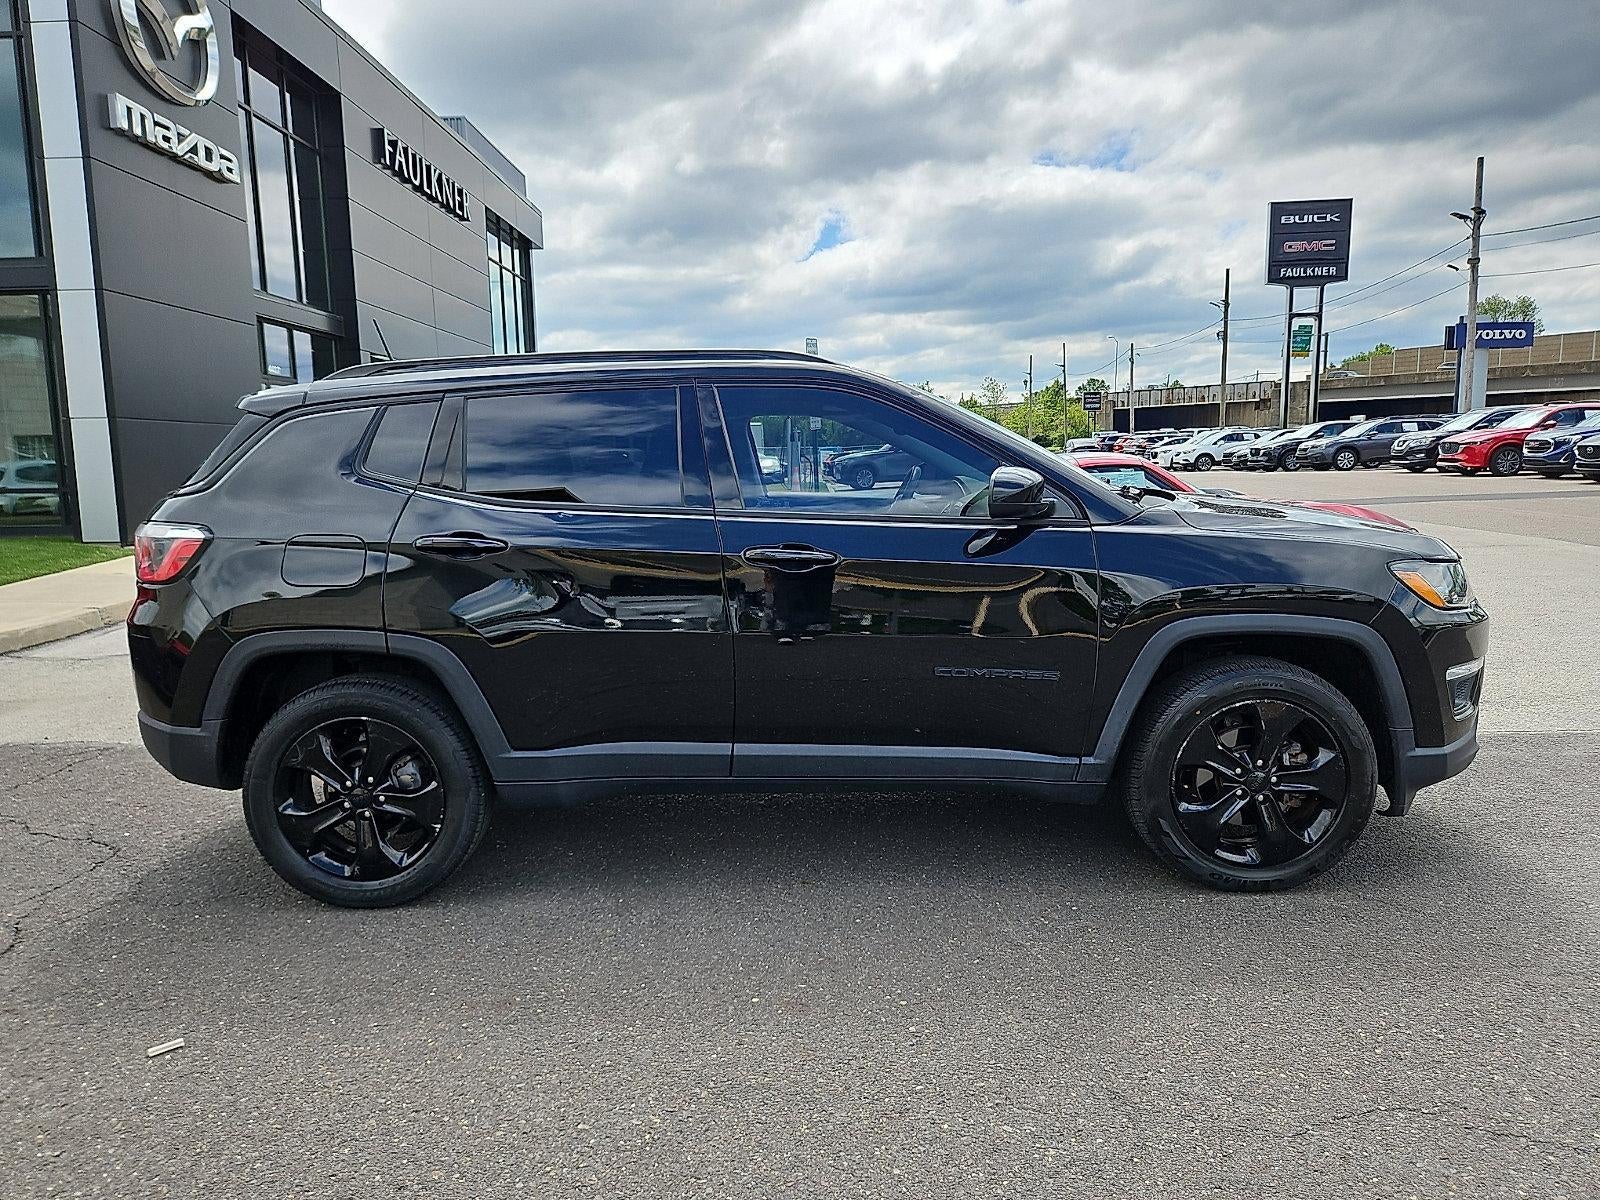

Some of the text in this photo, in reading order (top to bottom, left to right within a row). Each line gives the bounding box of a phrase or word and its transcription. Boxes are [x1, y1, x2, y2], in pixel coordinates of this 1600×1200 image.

[382, 127, 472, 222] FAULKNER
[1280, 213, 1341, 225] BUICK
[1283, 239, 1336, 253] GMC
[1280, 266, 1337, 278] FAULKNER
[934, 666, 1061, 681] COMPASS
